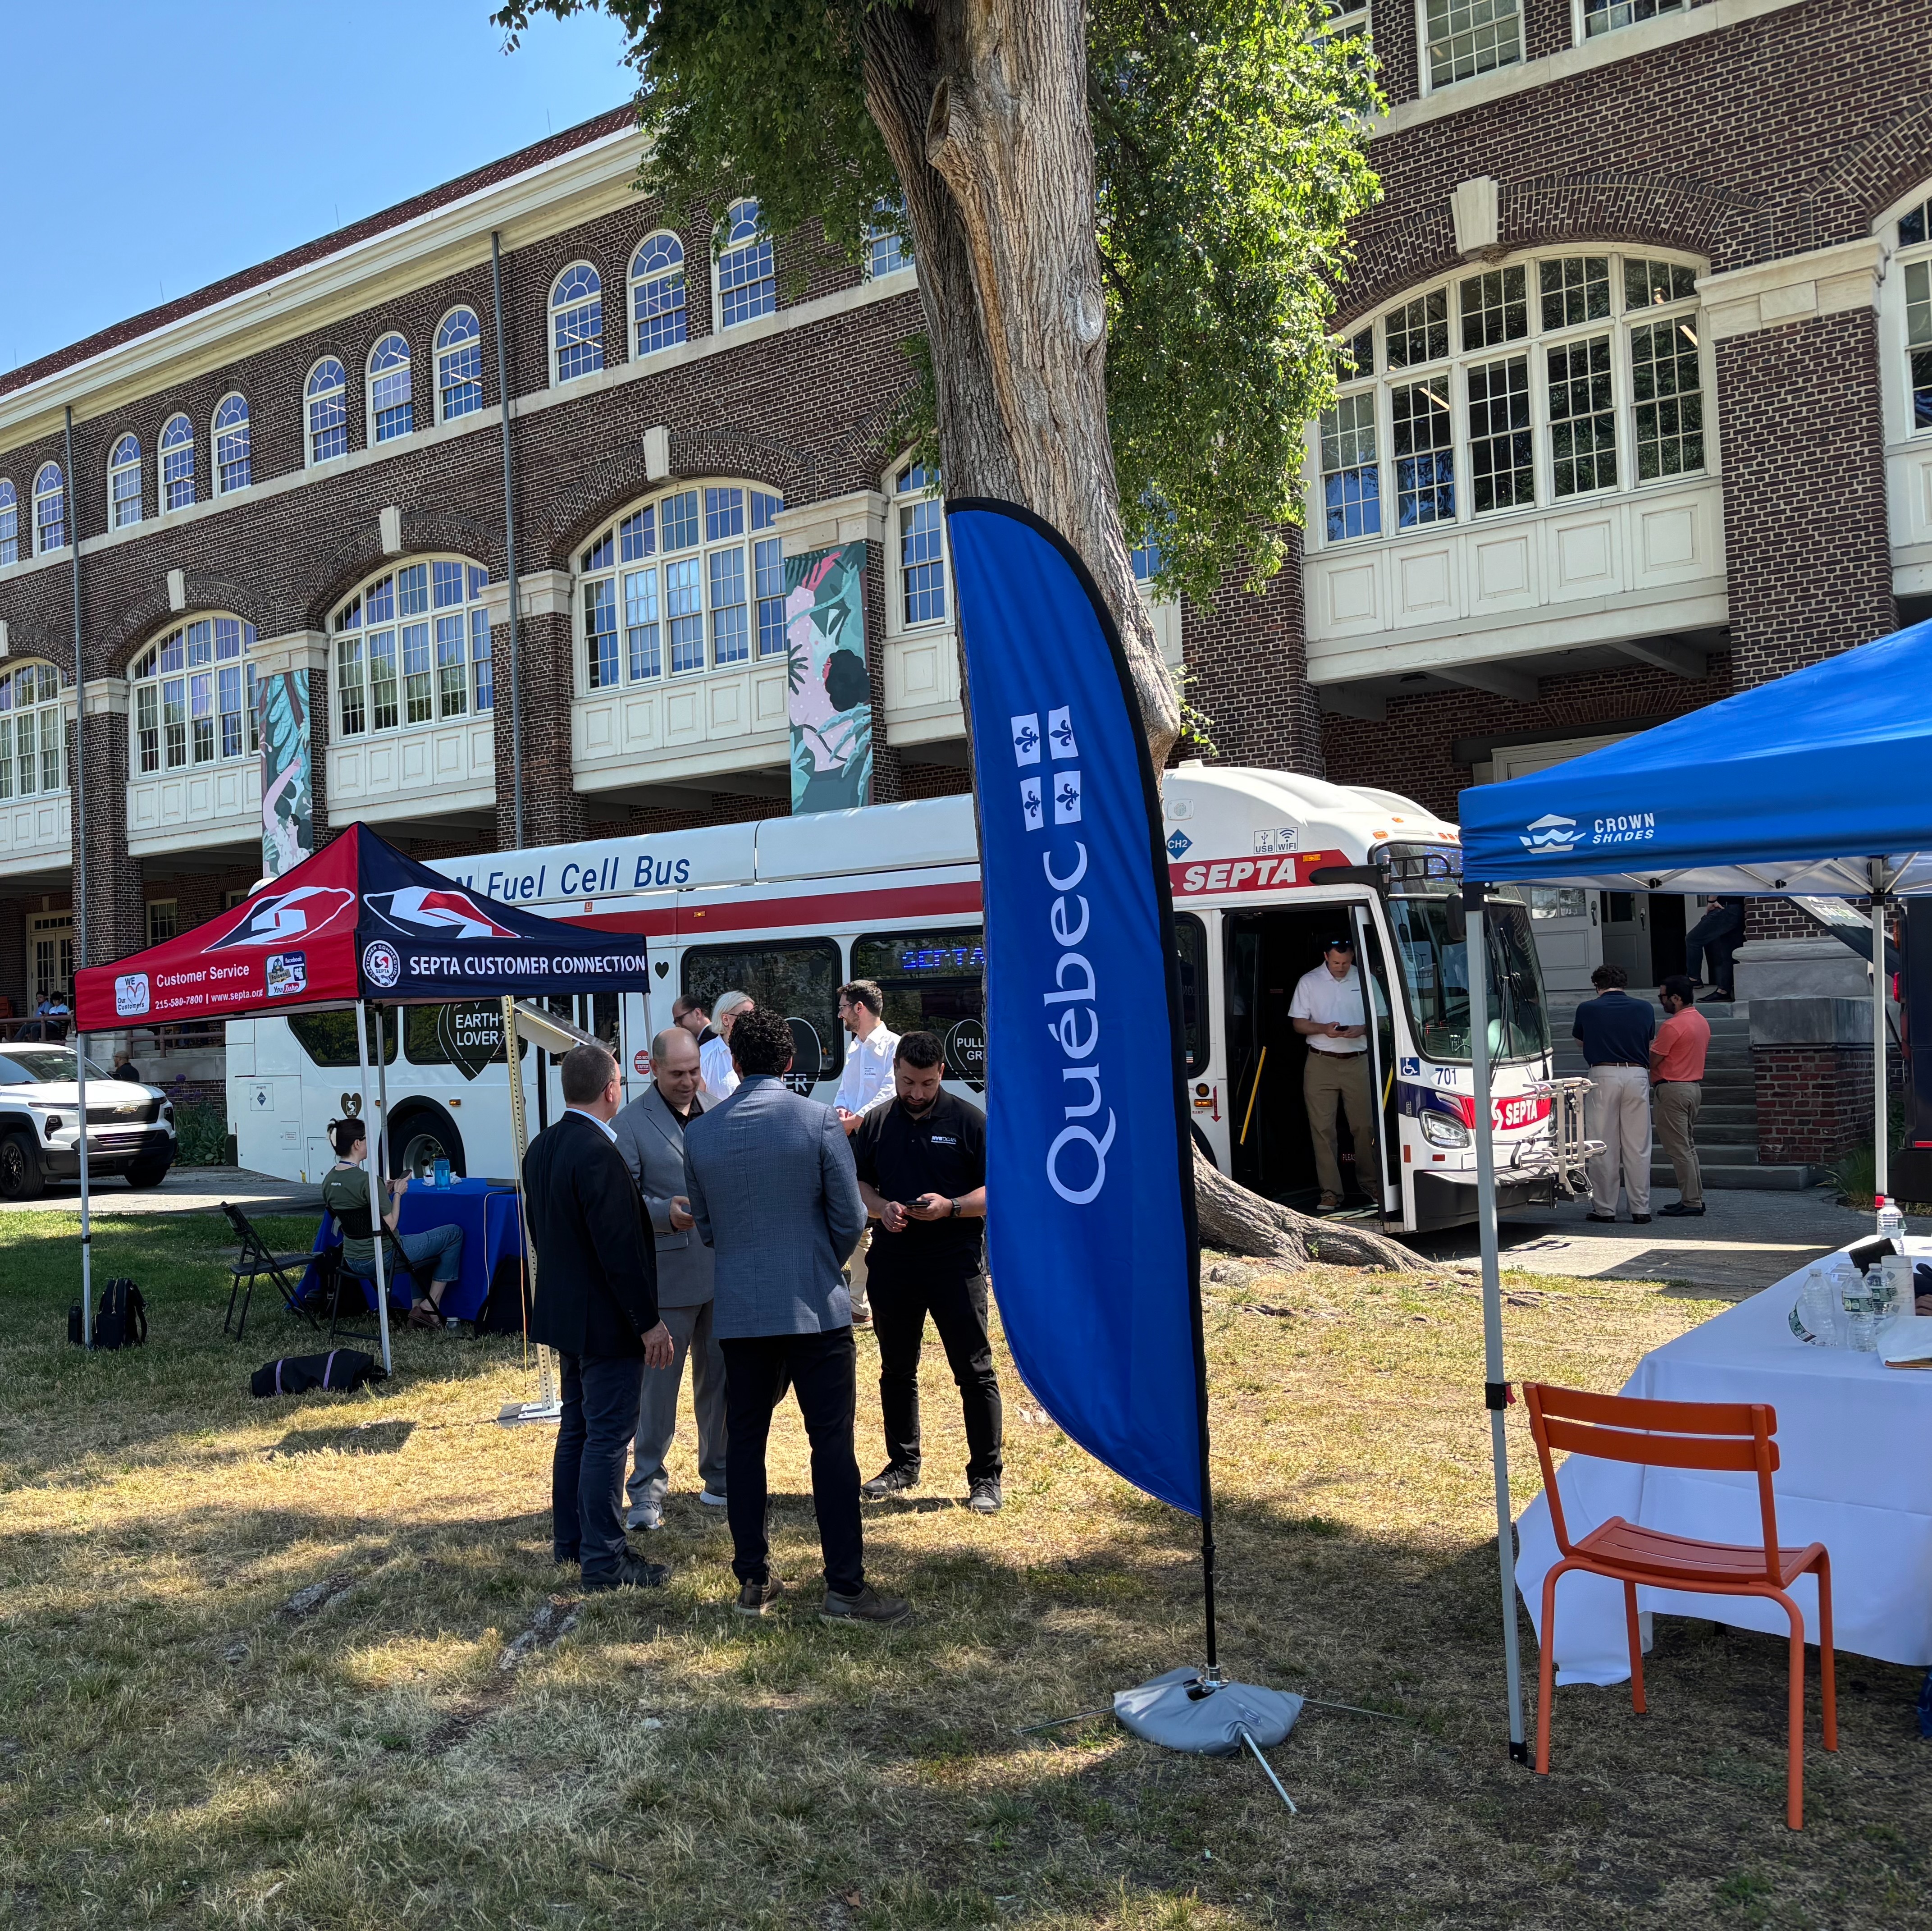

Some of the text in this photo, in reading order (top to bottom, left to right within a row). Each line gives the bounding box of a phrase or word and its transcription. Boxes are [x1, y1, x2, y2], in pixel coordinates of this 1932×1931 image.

[1594, 813, 1655, 833] CROWN
[1167, 839, 1188, 849] CH2
[1278, 842, 1296, 851] WIFI
[1592, 829, 1654, 844] SHADES
[1255, 845, 1273, 853] USB
[487, 856, 690, 901] Fuel Cell Bus
[1183, 858, 1297, 892] SEPTA
[410, 955, 646, 975] SEPTA CUSTOMER CONNECTION
[902, 947, 985, 968] SEPTA
[125, 977, 135, 986] WE
[157, 964, 250, 988] Customer Service
[155, 994, 203, 1009] 215-580-7800
[211, 988, 263, 1002] www.septa.org
[456, 1013, 498, 1028] EARTH
[1043, 841, 1116, 1205] Québec
[457, 1030, 499, 1046] LOVER
[1435, 1068, 1457, 1085] 701
[1505, 1100, 1538, 1126] SEPTA
